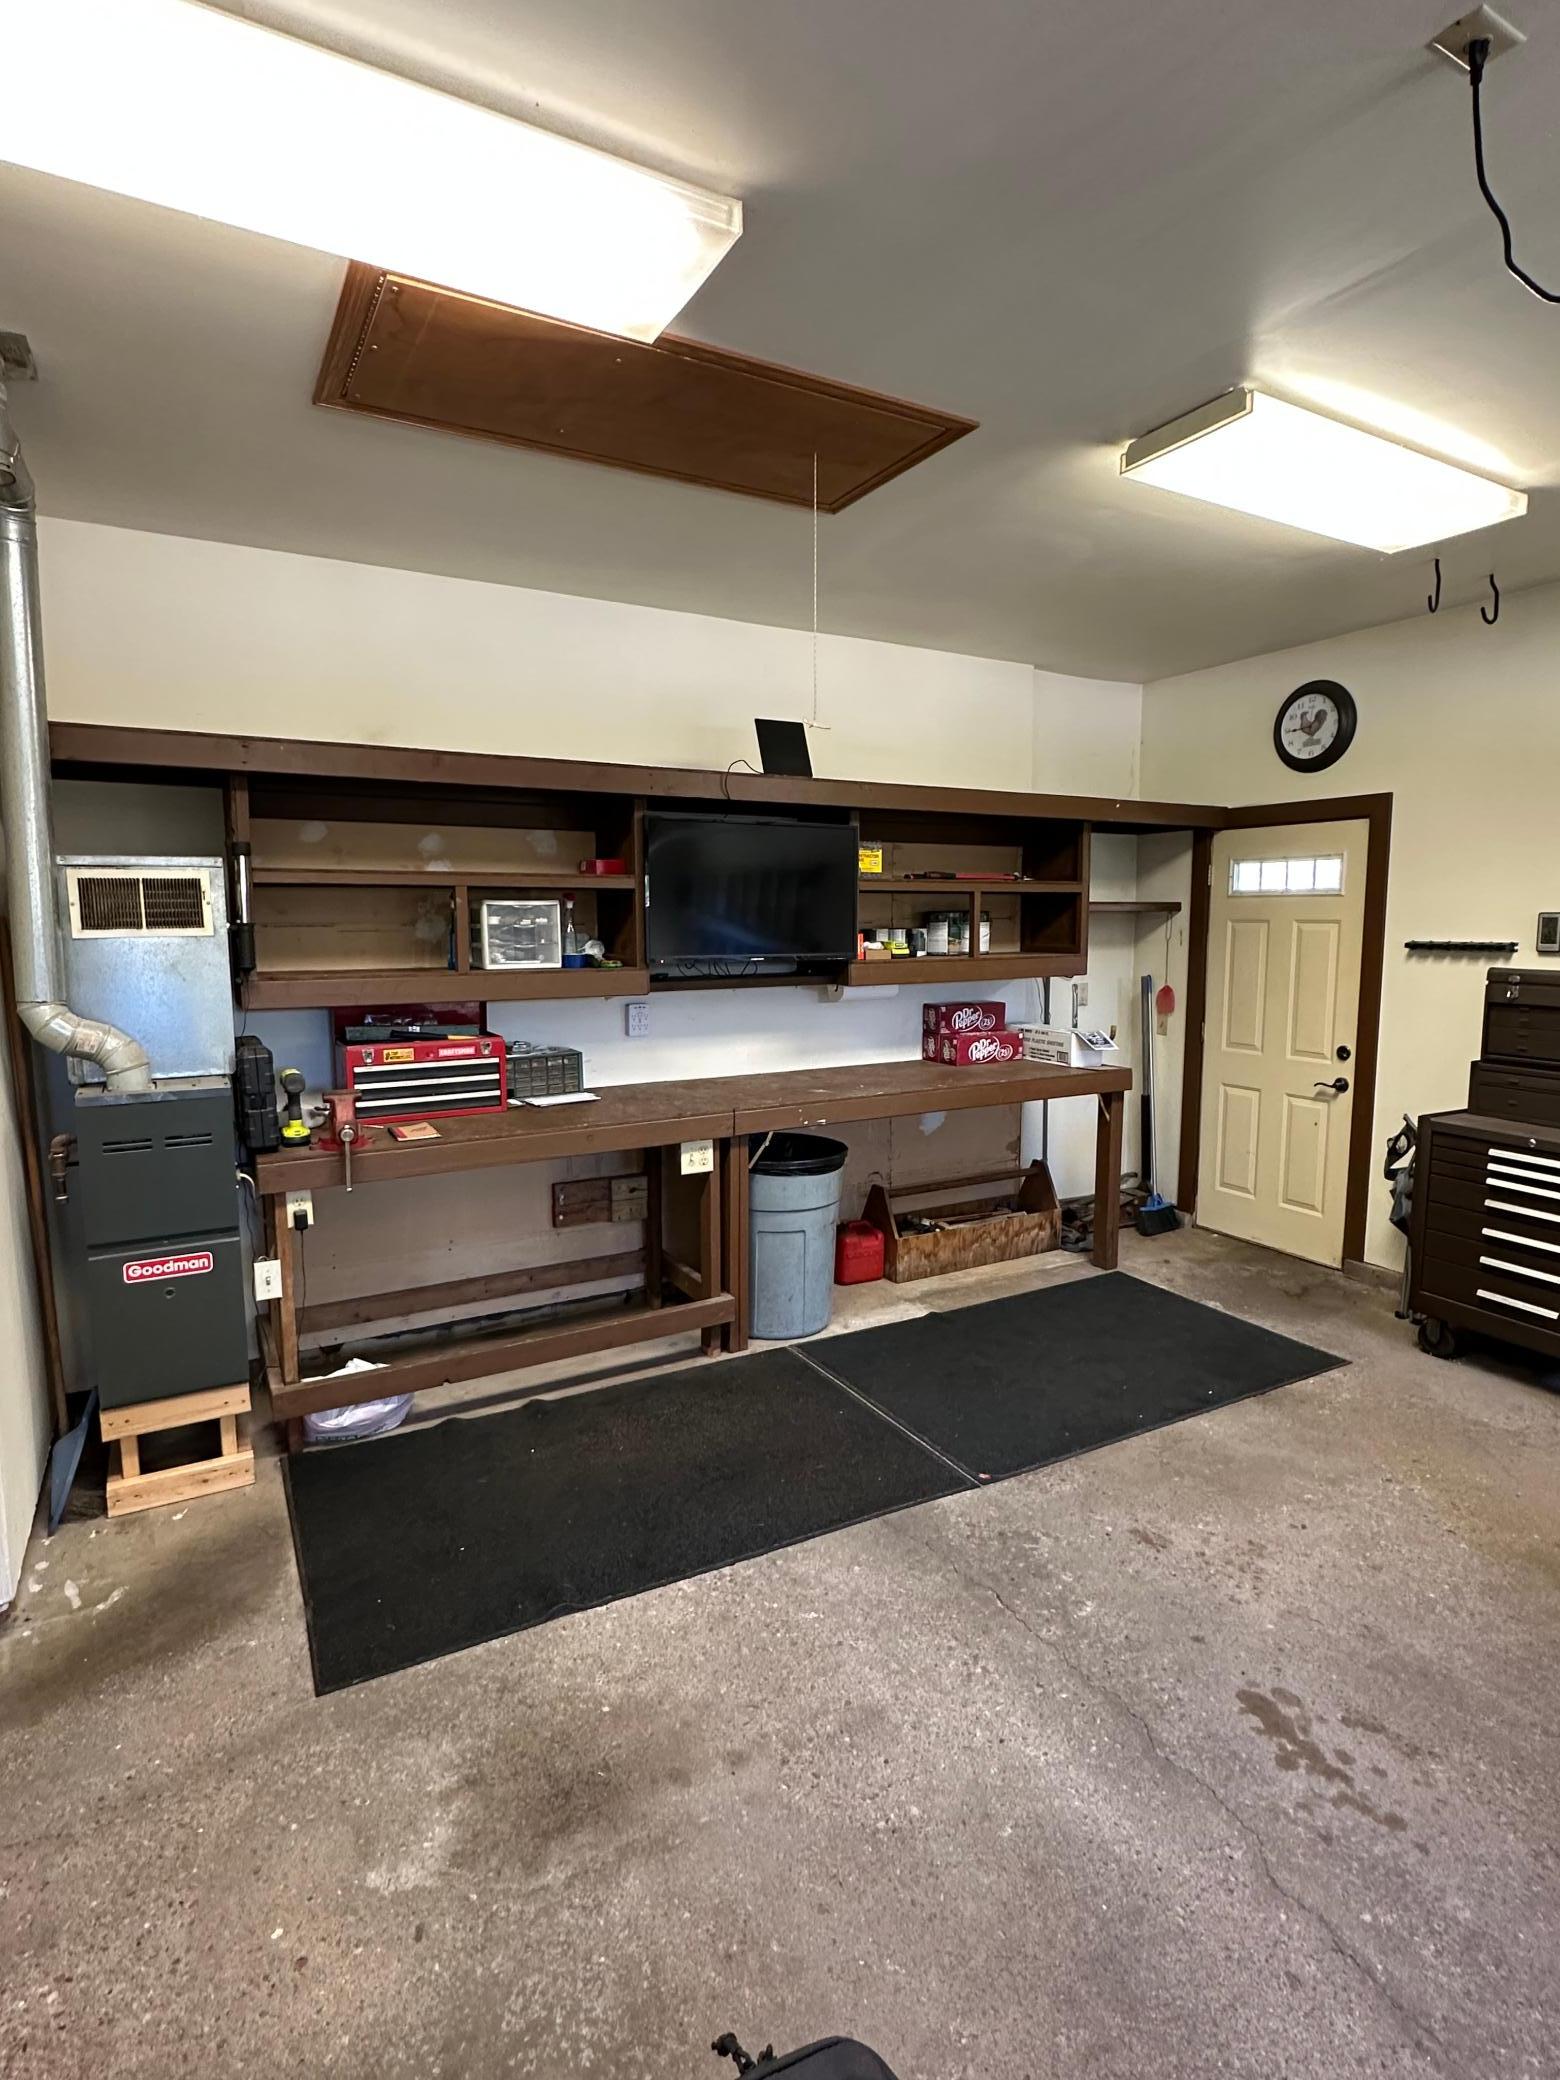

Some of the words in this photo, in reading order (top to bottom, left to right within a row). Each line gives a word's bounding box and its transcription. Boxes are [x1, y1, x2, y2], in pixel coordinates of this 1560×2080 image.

[955, 1011, 980, 1030] Pepper
[963, 1008, 974, 1017] Dr
[972, 1042, 998, 1061] Pepper
[980, 1038, 991, 1047] Dr
[128, 1258, 208, 1277] Goodman
